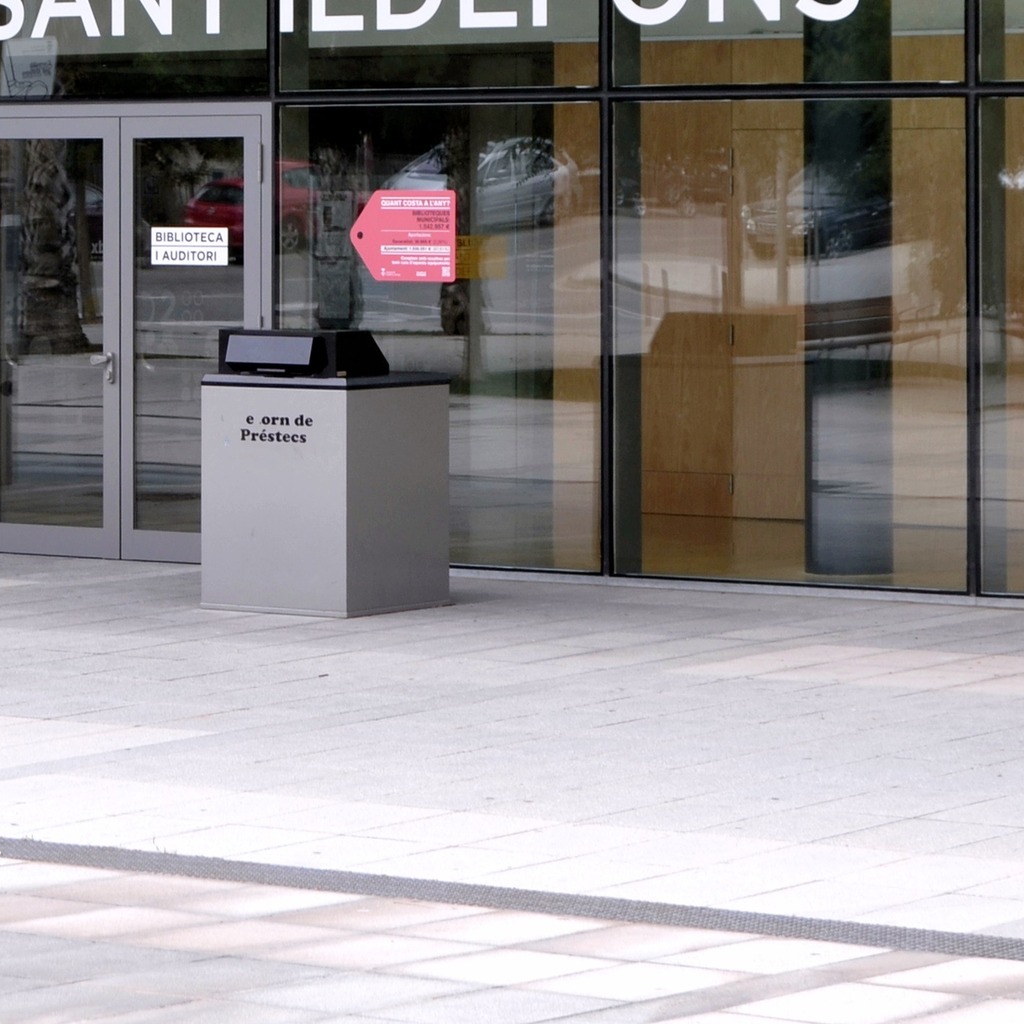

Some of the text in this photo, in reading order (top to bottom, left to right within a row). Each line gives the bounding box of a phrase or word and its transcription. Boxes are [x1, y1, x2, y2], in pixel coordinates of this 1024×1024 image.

[155, 231, 224, 243] BIBLIOTECA
[155, 250, 218, 262] I AUDITORI
[294, 414, 314, 427] de
[240, 428, 307, 444] Préstecs
